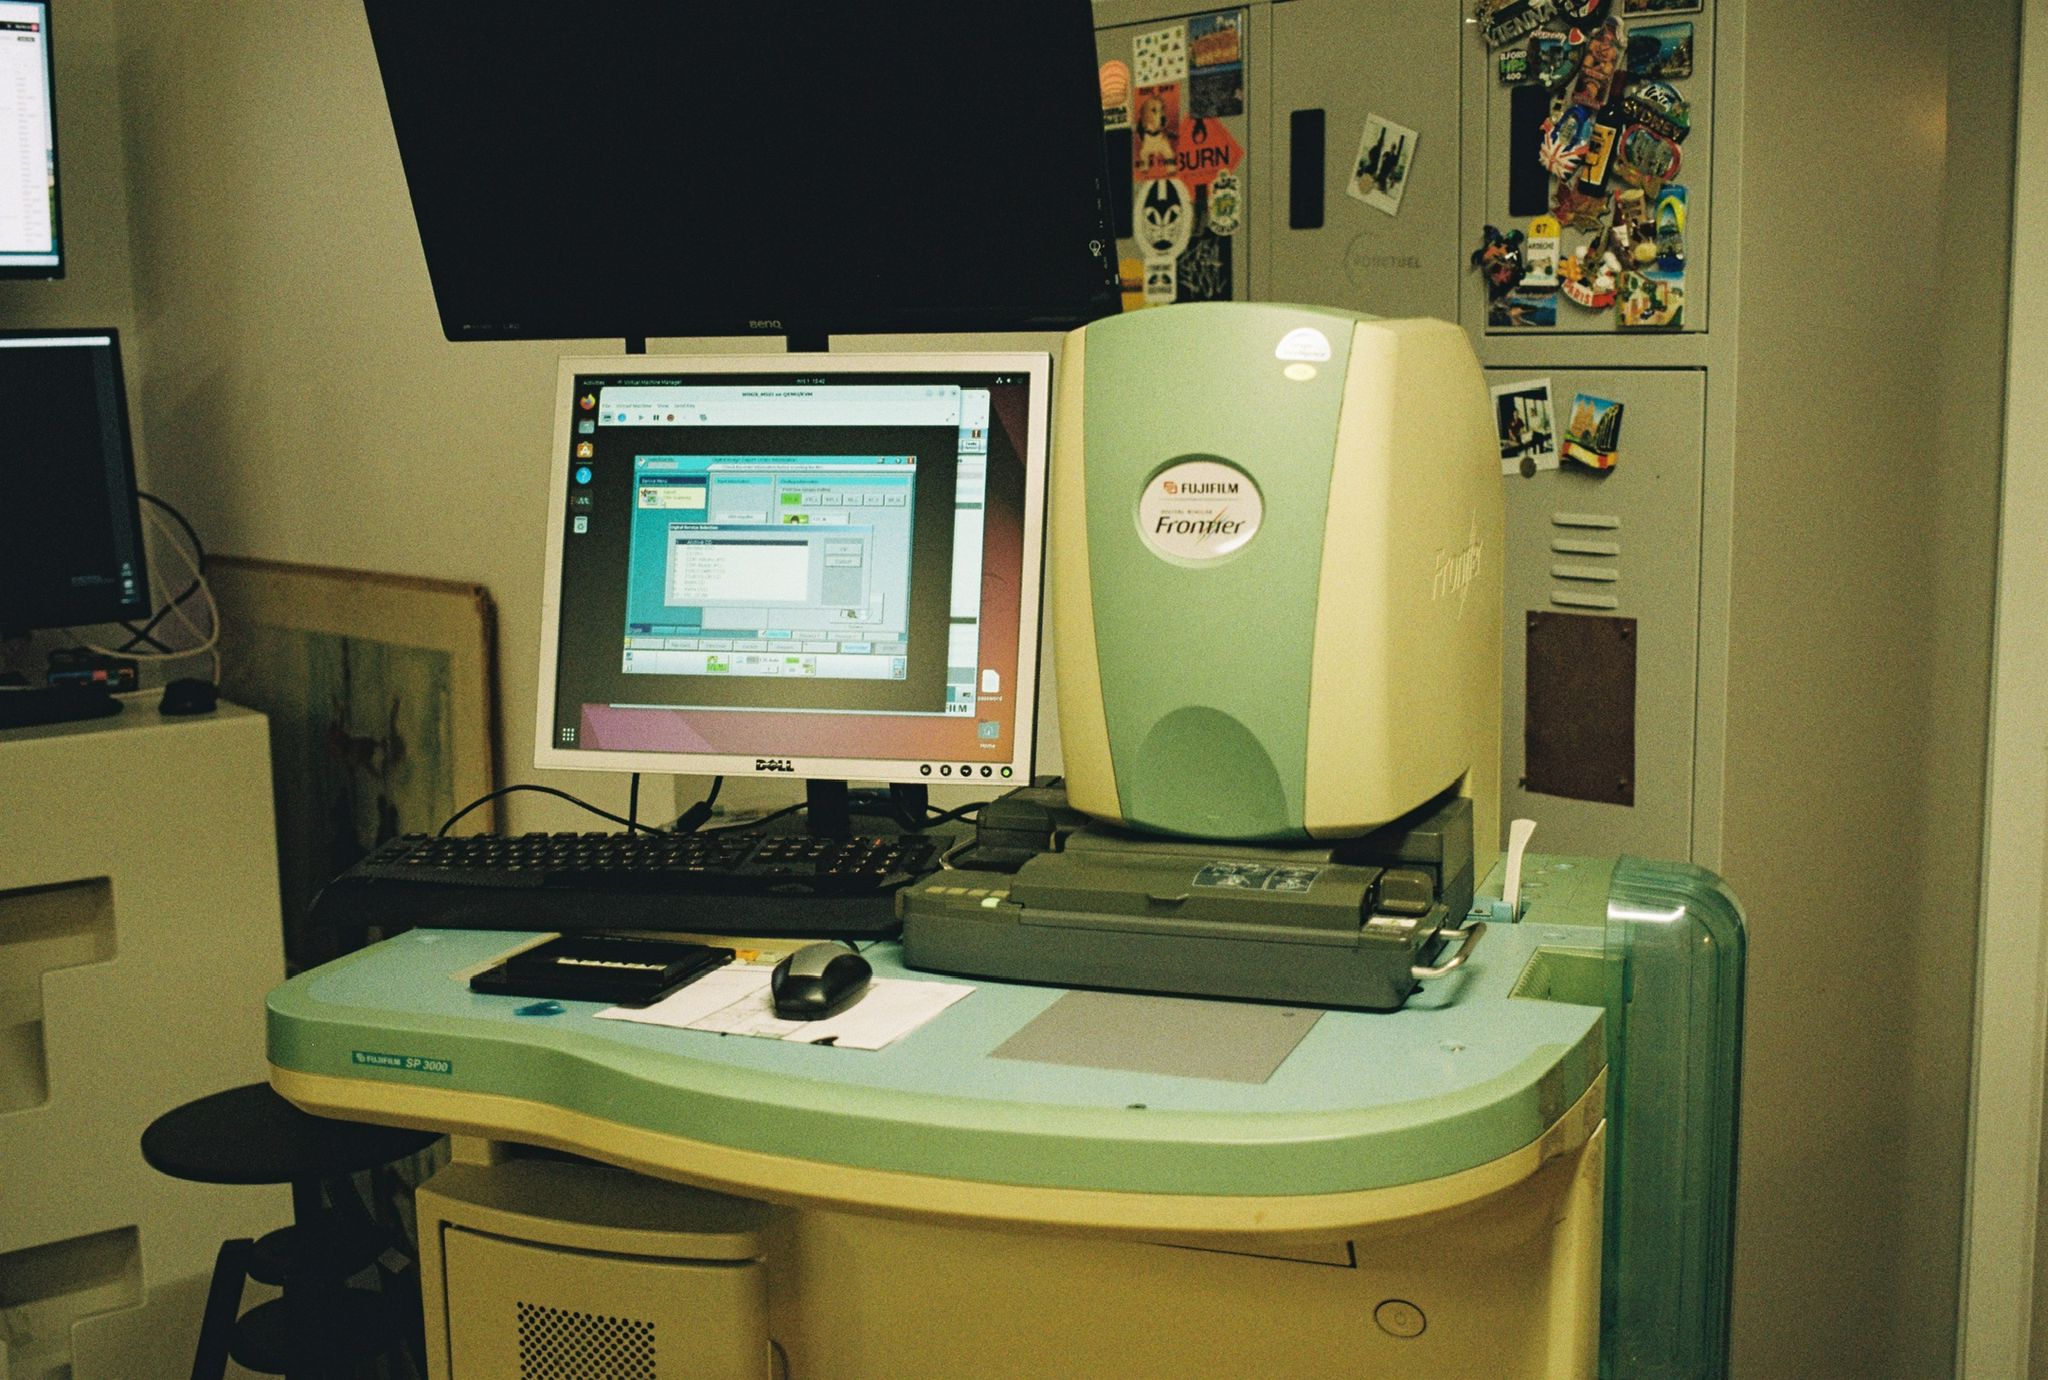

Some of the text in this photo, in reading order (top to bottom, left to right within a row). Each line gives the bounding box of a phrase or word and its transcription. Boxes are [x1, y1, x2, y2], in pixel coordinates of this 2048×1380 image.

[1482, 4, 1557, 46] VIENNA
[1500, 50, 1527, 60] ILFORD
[1506, 72, 1521, 80] 400
[1178, 145, 1229, 171] BURN
[1563, 279, 1591, 305] PARIS
[749, 319, 783, 329] BenQ
[1181, 483, 1239, 494] FUJIFILM
[1155, 515, 1246, 535] Frontier
[946, 704, 968, 713] ILM
[755, 759, 795, 772] DELL
[366, 1055, 449, 1072] FUJIFILM SP 3000
